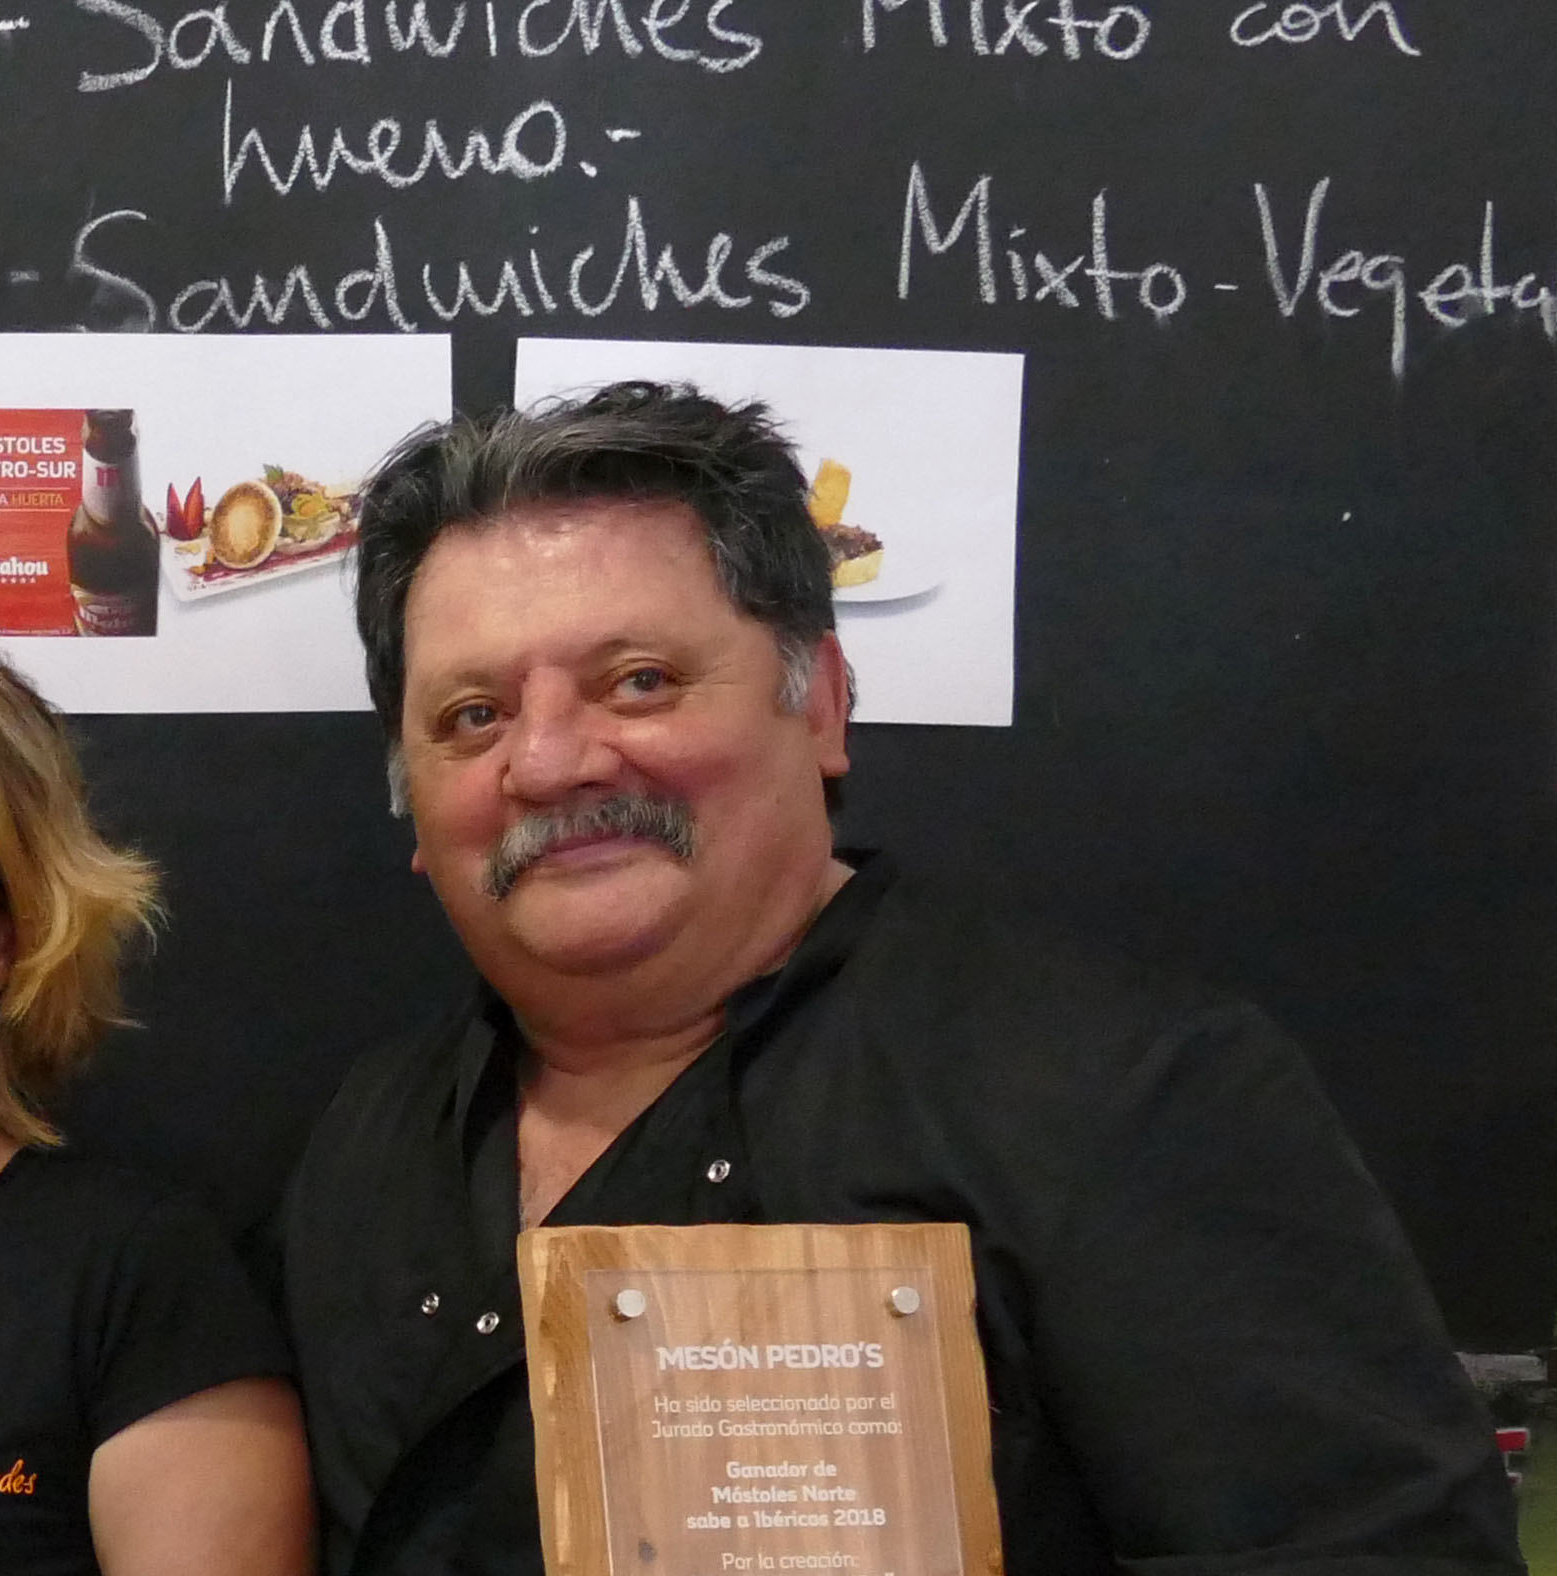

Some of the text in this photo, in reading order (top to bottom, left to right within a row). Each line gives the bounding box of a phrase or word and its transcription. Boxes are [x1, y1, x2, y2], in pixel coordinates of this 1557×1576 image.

[1230, 0, 1421, 56] con
[71, 199, 811, 333] Sandwiches
[12, 492, 65, 506] HUERTA
[656, 1338, 885, 1371] MESÓN PEDRO'S
[655, 1393, 895, 1413] Ha sido seleccionado por el
[652, 1418, 903, 1438] Jurado Gastronómico como:
[726, 1460, 837, 1479] Ganador de
[711, 1485, 857, 1504] Móstoles Norte
[687, 1508, 886, 1529] sabe a Ibéricos 2018
[721, 1552, 753, 1570] Por
[758, 1553, 774, 1569] la
